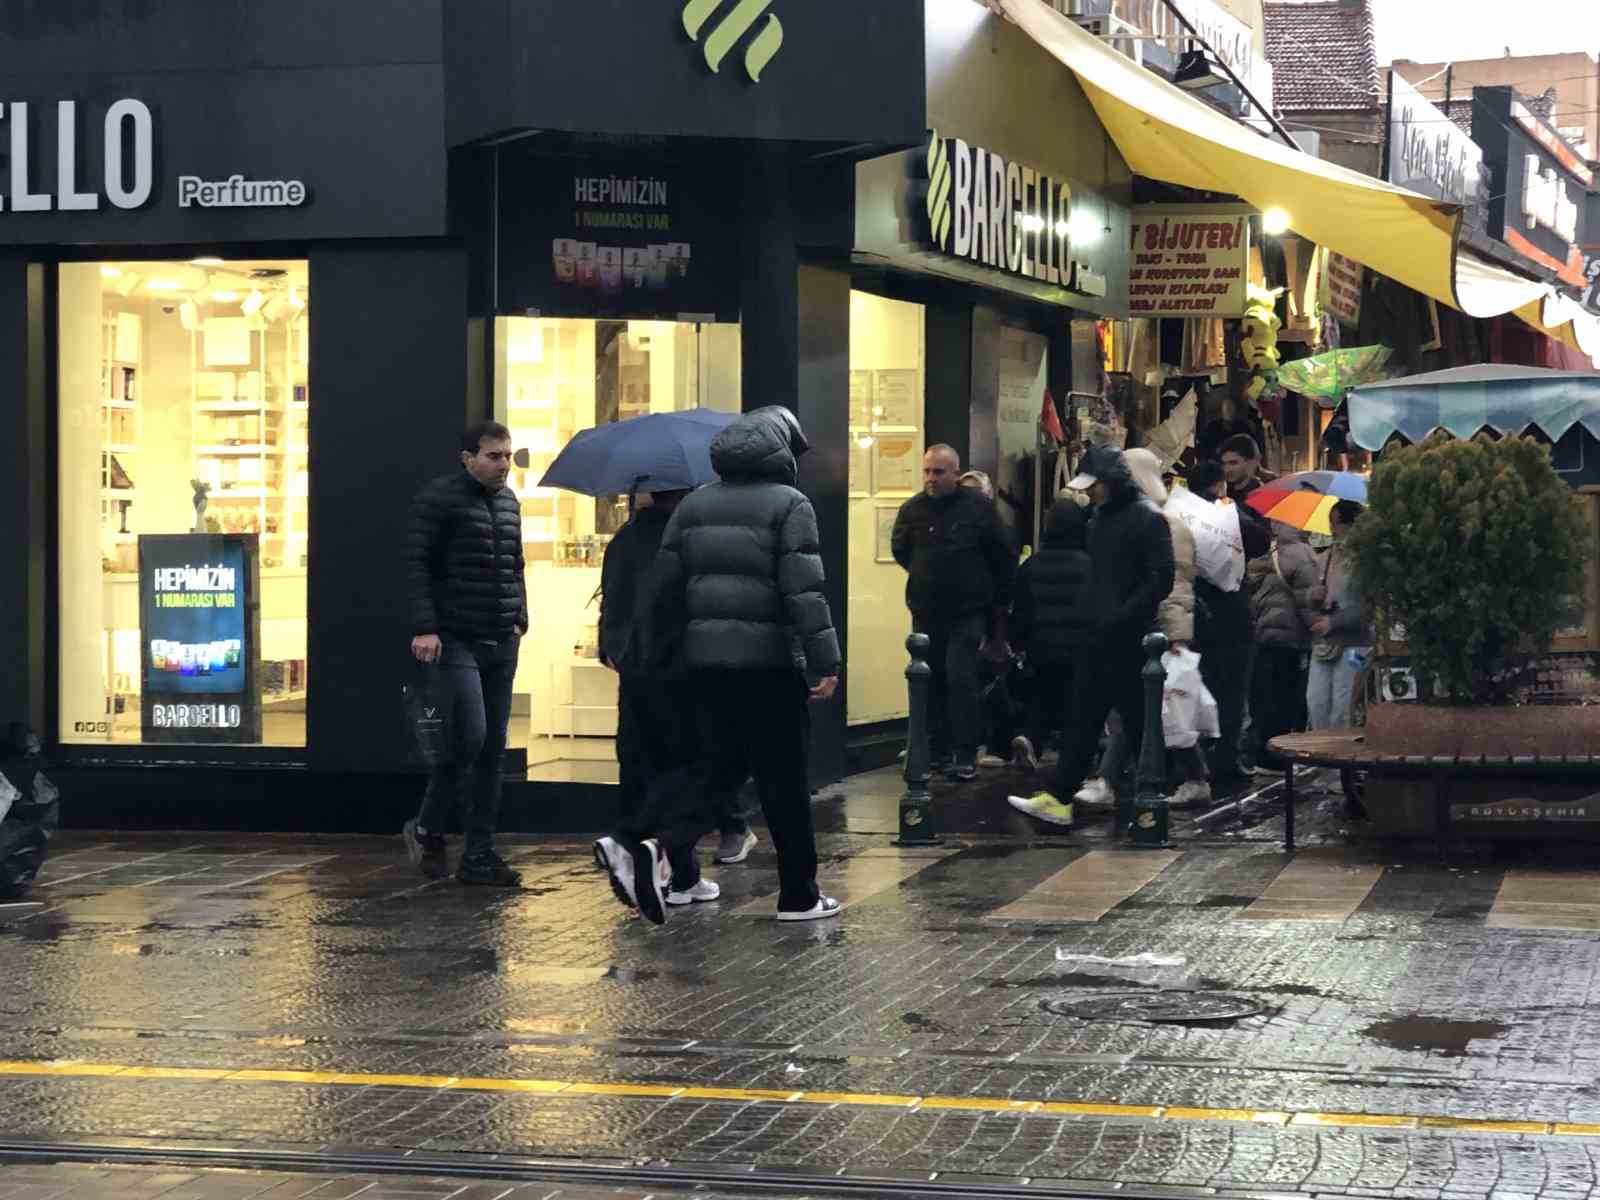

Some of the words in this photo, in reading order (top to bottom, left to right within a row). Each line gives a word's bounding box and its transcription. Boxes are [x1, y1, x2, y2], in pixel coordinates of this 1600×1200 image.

[0, 98, 153, 211] LLO
[178, 175, 306, 207] Perfume
[574, 173, 668, 206] HEPİMİZİN
[583, 211, 644, 229] NUMARASI
[646, 213, 671, 230] VAR
[1145, 216, 1243, 251] BİJUTERİ
[153, 563, 236, 592] HEPİMİZİN
[154, 592, 161, 608] 1
[162, 592, 214, 608] NUMARASI
[215, 592, 236, 608] VAR
